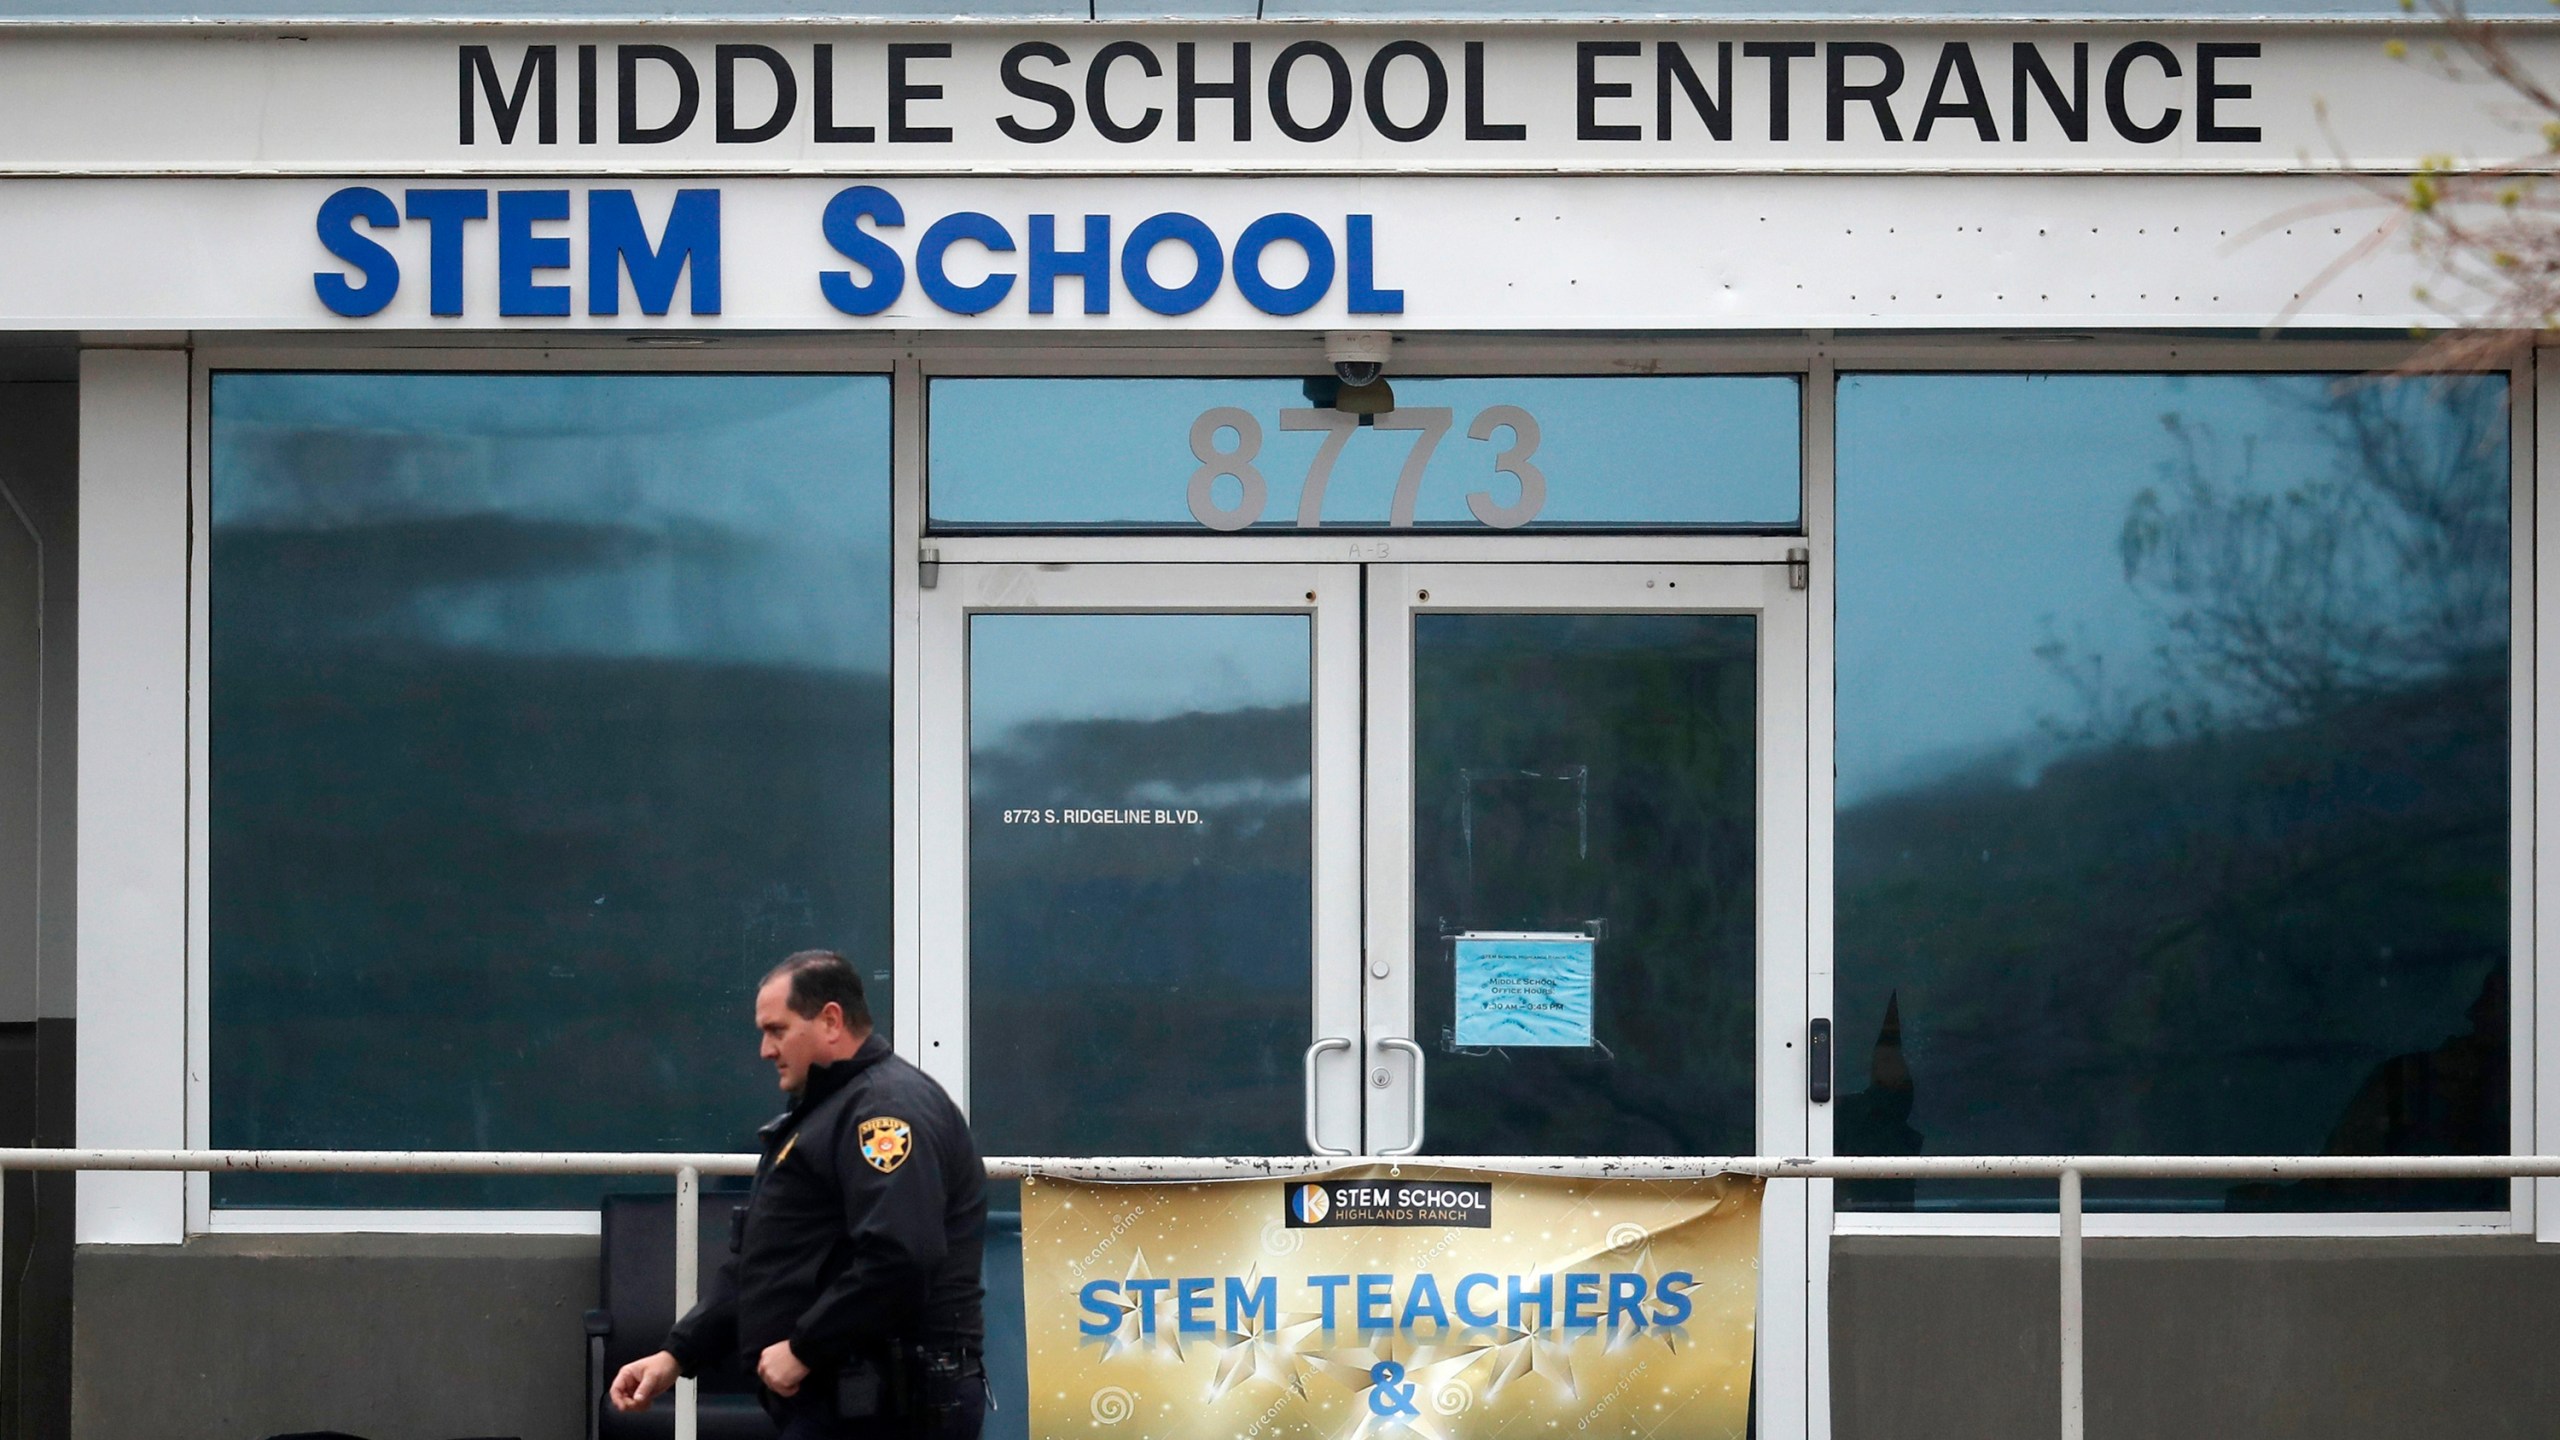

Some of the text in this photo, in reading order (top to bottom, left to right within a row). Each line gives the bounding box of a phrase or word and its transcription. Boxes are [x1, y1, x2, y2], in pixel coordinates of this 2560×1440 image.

[459, 40, 2261, 144] MIDDLE SCHOOL ENTRANCE
[314, 186, 1404, 317] STEM SCHOOL
[1187, 405, 1546, 531] 8773
[1003, 809, 1204, 825] 8773 S. RIDGELINE BLVD.
[1490, 977, 1557, 987] MIDDLE SCHOOL
[1491, 986, 1522, 994] OFFICE
[1335, 1208, 1468, 1221] HIGHLANDS RANCH
[1336, 1188, 1487, 1210] STEM SCHOOL
[1073, 1206, 1145, 1276] dreamstime
[1079, 1272, 1693, 1337] STEM TEACHERS
[1368, 1360, 1421, 1417] &
[1577, 1360, 1647, 1431] dreamstime
